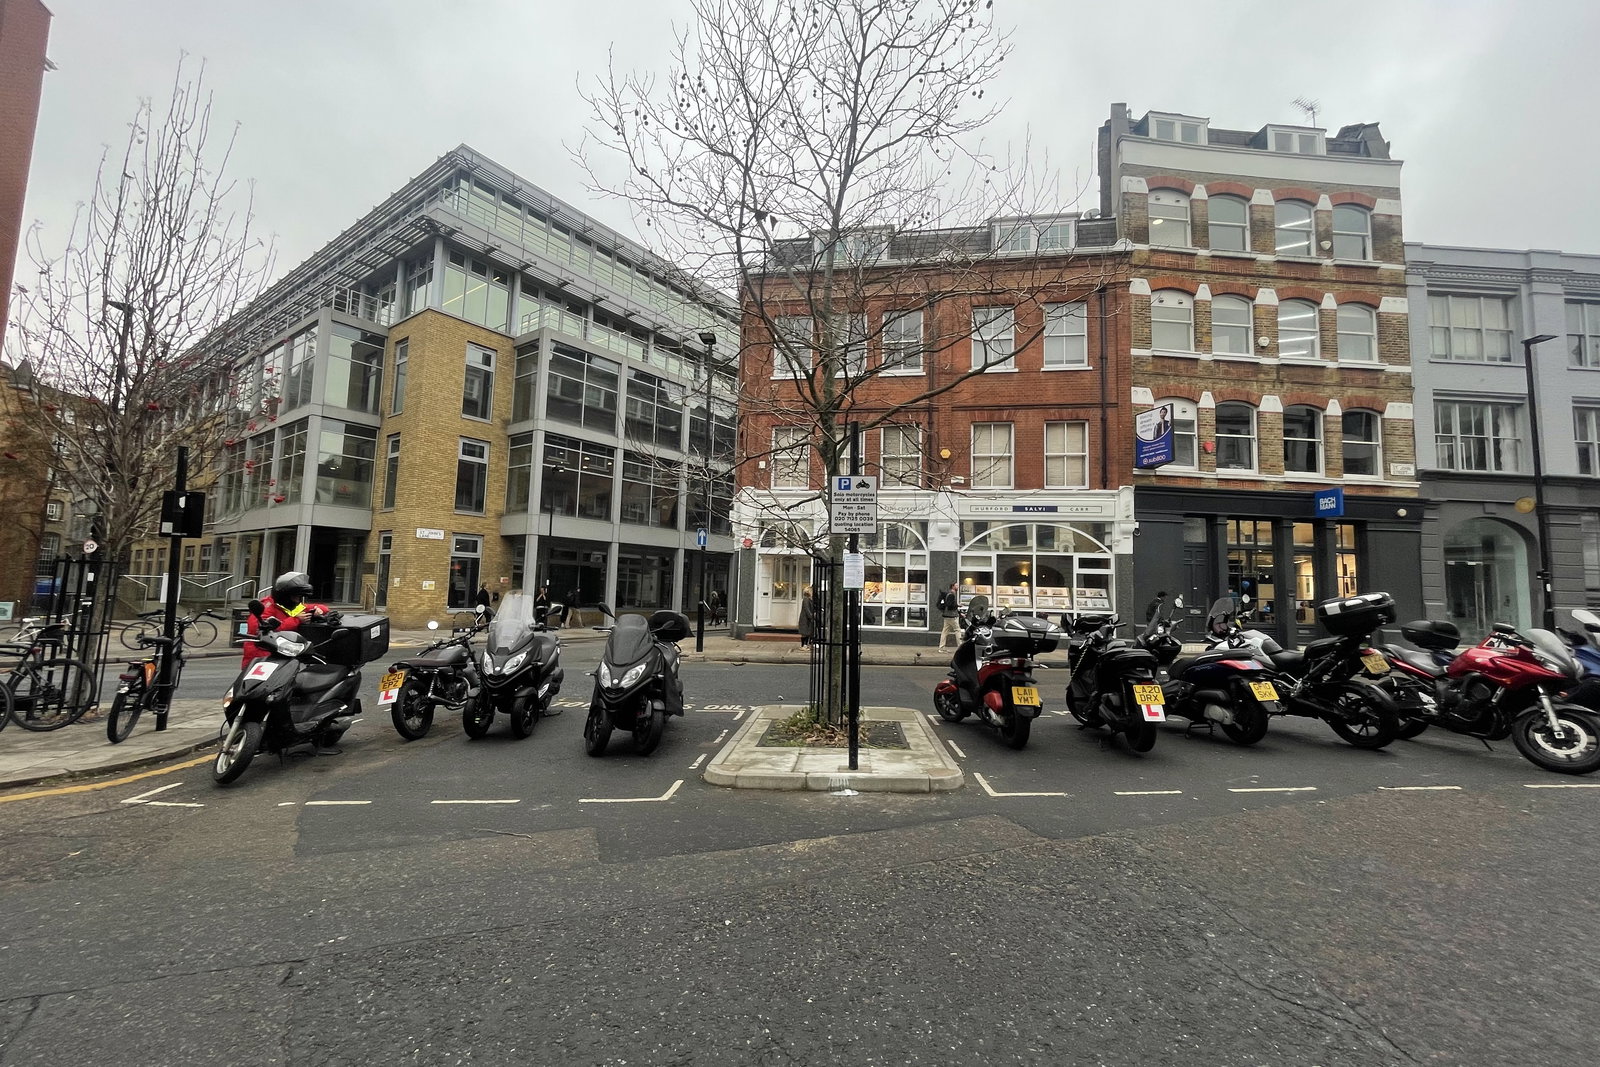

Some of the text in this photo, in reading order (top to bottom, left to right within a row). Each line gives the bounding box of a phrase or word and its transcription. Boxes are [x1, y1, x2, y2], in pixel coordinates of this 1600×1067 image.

[841, 479, 850, 489] P
[381, 672, 403, 683] LC20
[1133, 686, 1160, 694] LA20
[1139, 694, 1160, 702] DRX
[1145, 704, 1160, 717] L
